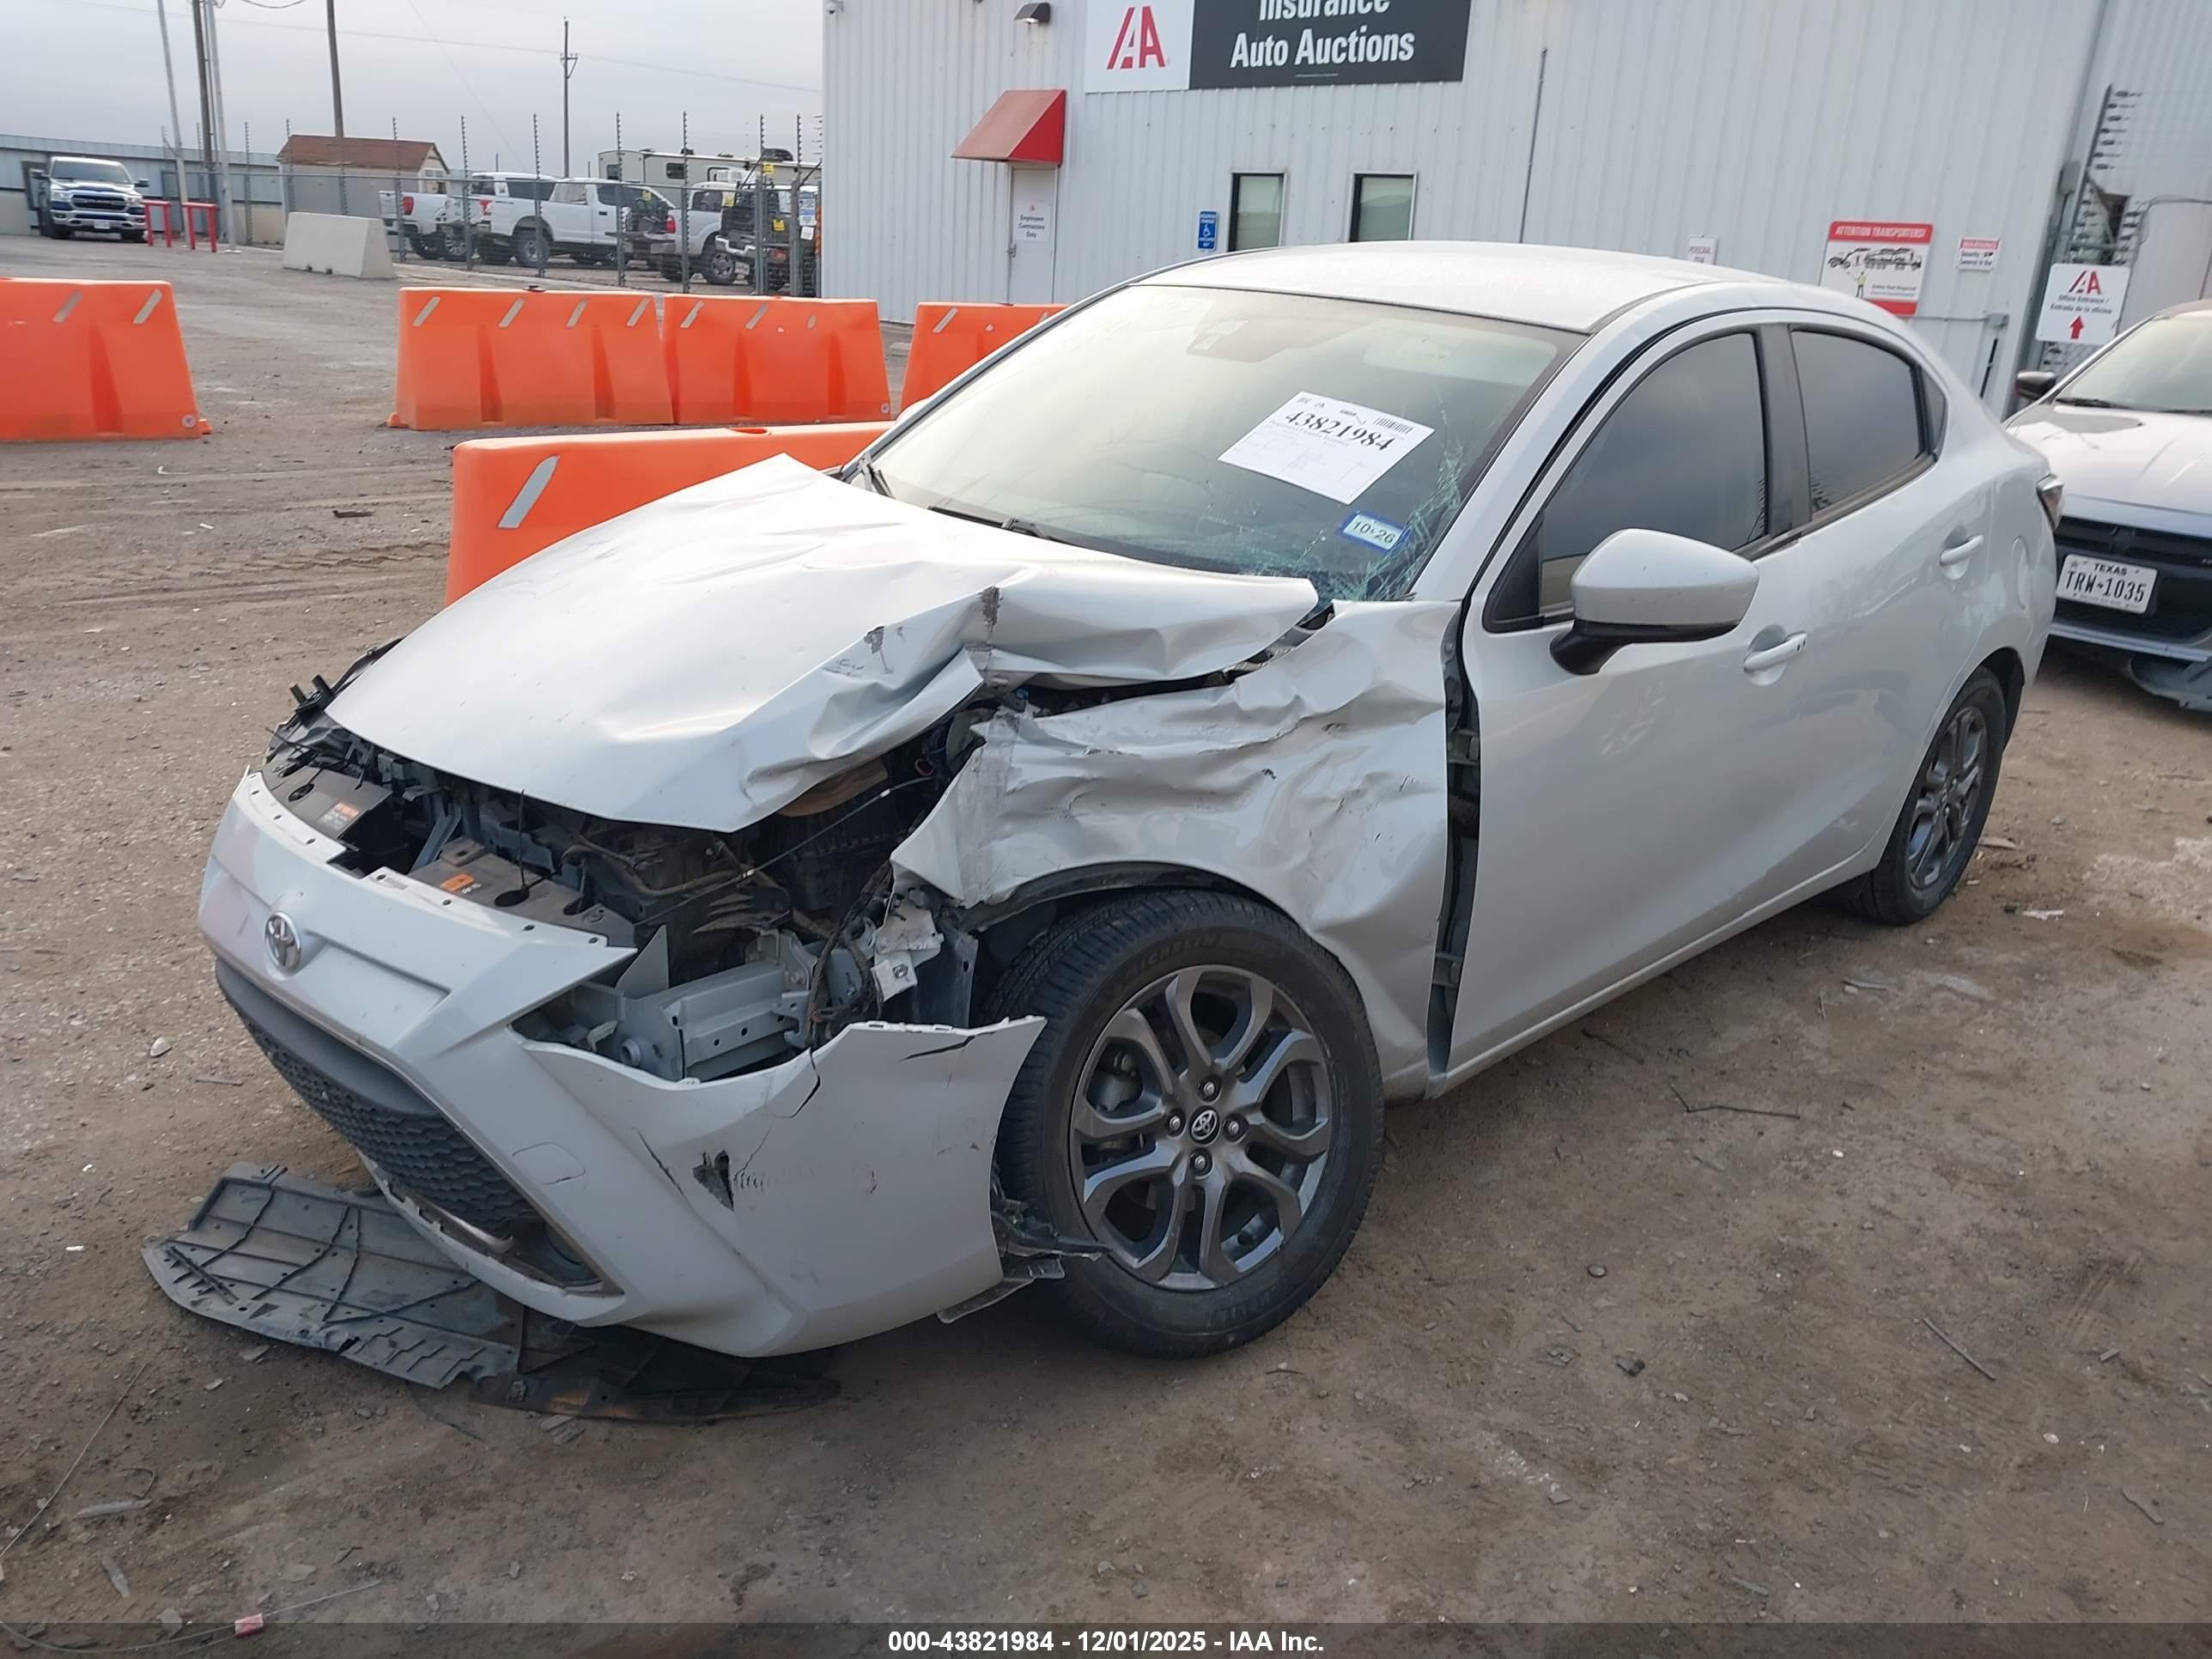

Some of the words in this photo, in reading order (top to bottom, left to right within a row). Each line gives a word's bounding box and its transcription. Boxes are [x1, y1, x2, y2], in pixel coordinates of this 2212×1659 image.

[1230, 33, 1289, 68] Auto
[1294, 25, 1416, 65] Auctions
[1835, 226, 1871, 236] ATTENTION
[1285, 410, 1396, 451] 43821984
[2094, 562, 2128, 576] TEXAS
